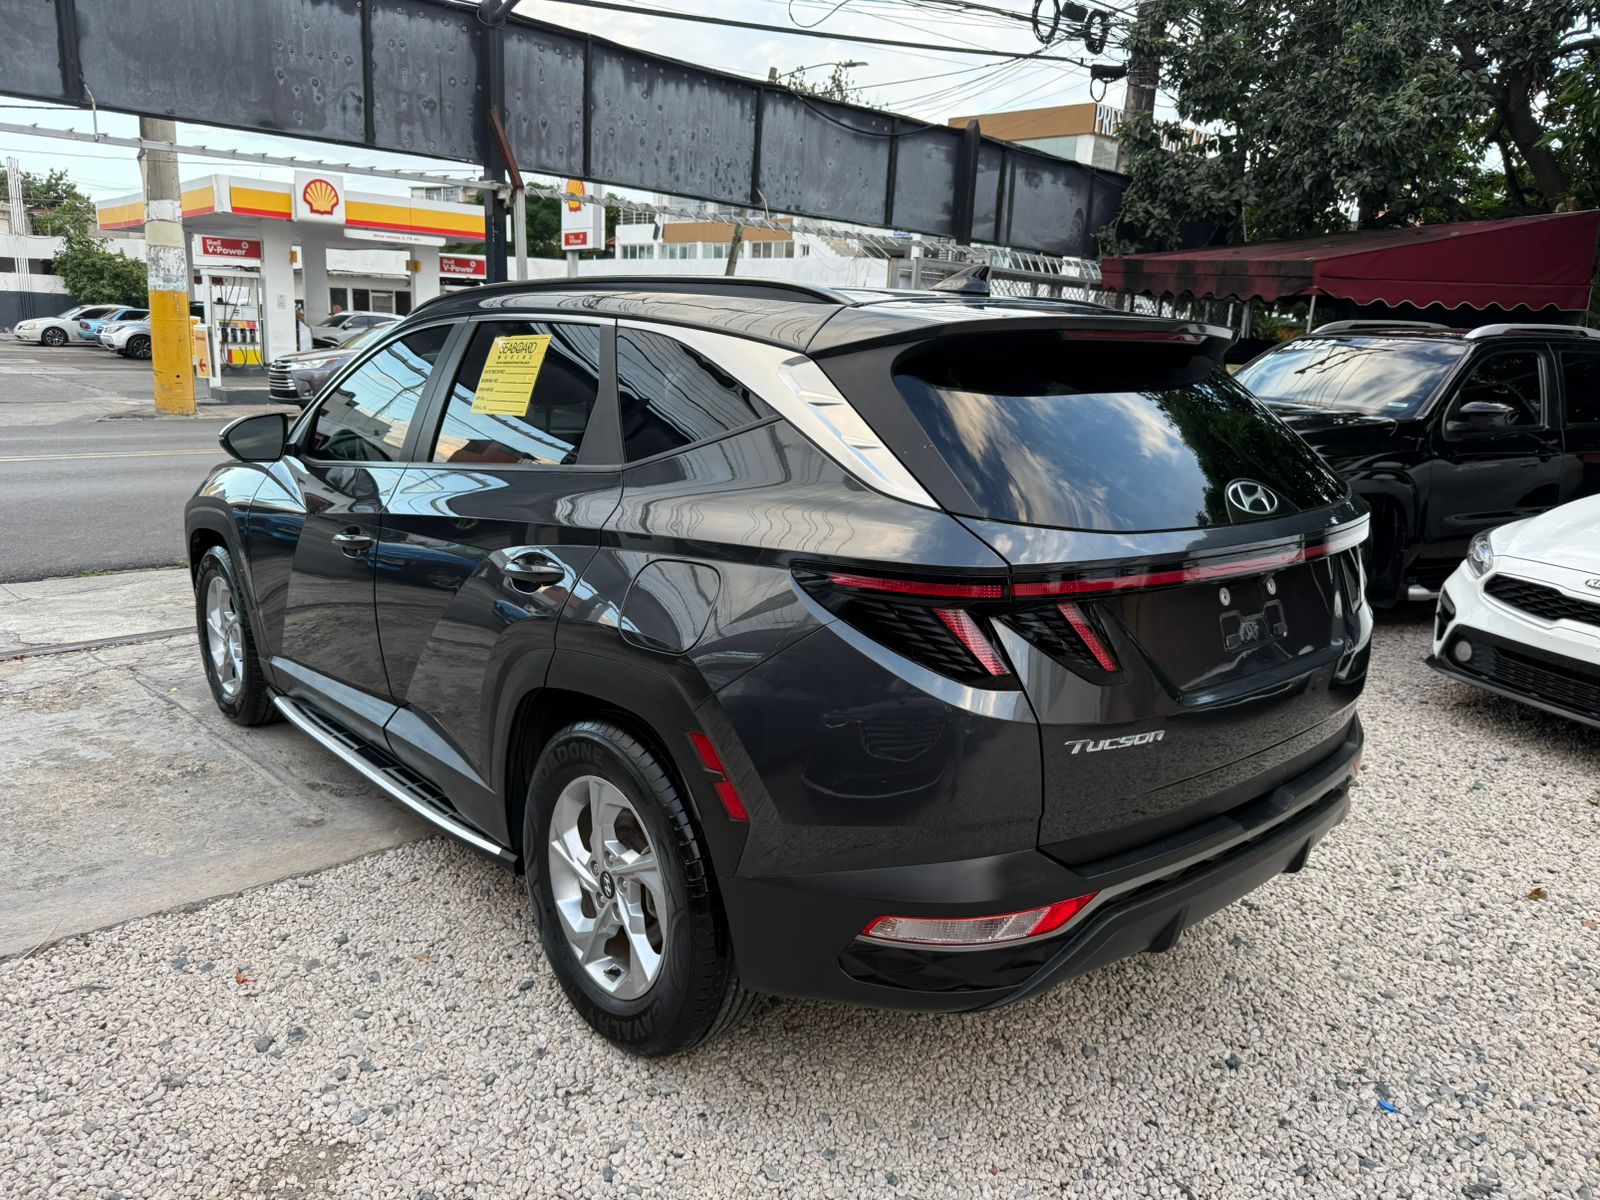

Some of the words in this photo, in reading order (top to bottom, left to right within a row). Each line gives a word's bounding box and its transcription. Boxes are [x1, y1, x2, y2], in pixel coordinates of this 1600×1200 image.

[206, 246, 247, 255] V-Power
[442, 263, 475, 273] V-Power
[1282, 340, 1337, 350] 2022
[1586, 579, 1600, 588] KI
